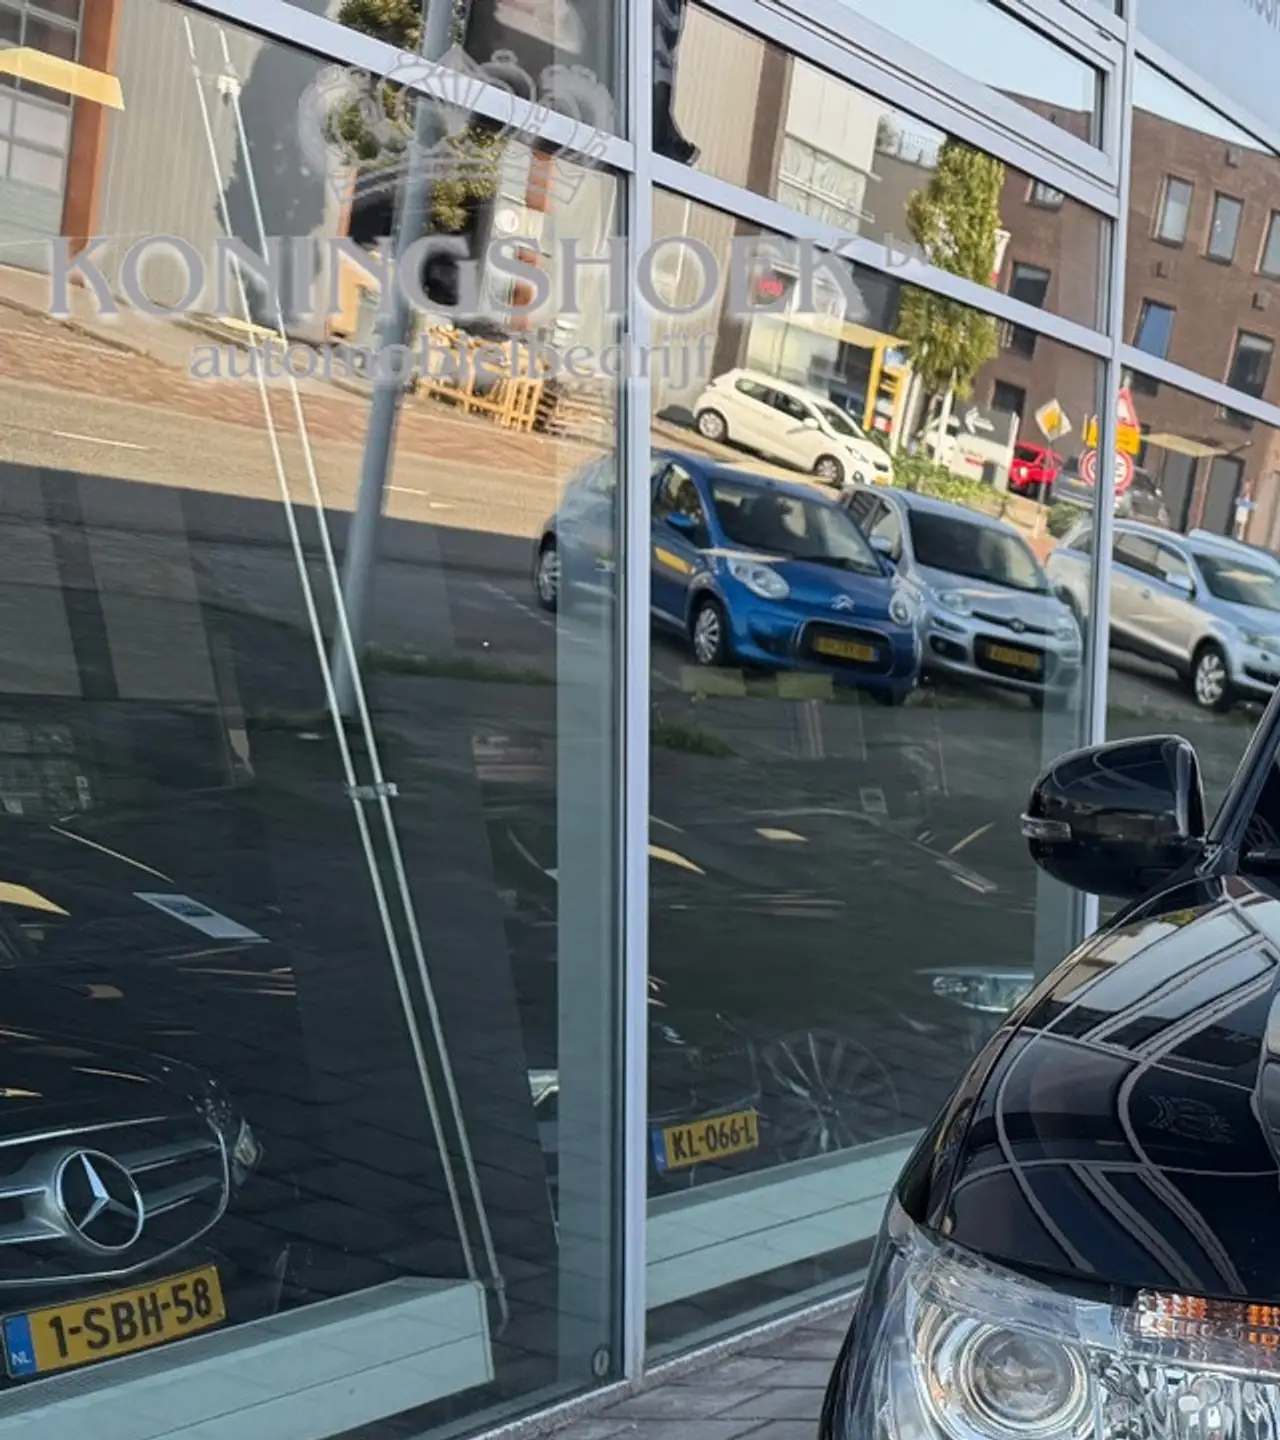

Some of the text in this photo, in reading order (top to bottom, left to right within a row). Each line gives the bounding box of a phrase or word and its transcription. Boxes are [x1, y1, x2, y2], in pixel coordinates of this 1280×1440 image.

[671, 1115, 756, 1162] KL-066-L
[11, 1277, 213, 1366] NL 1-SBH-58
